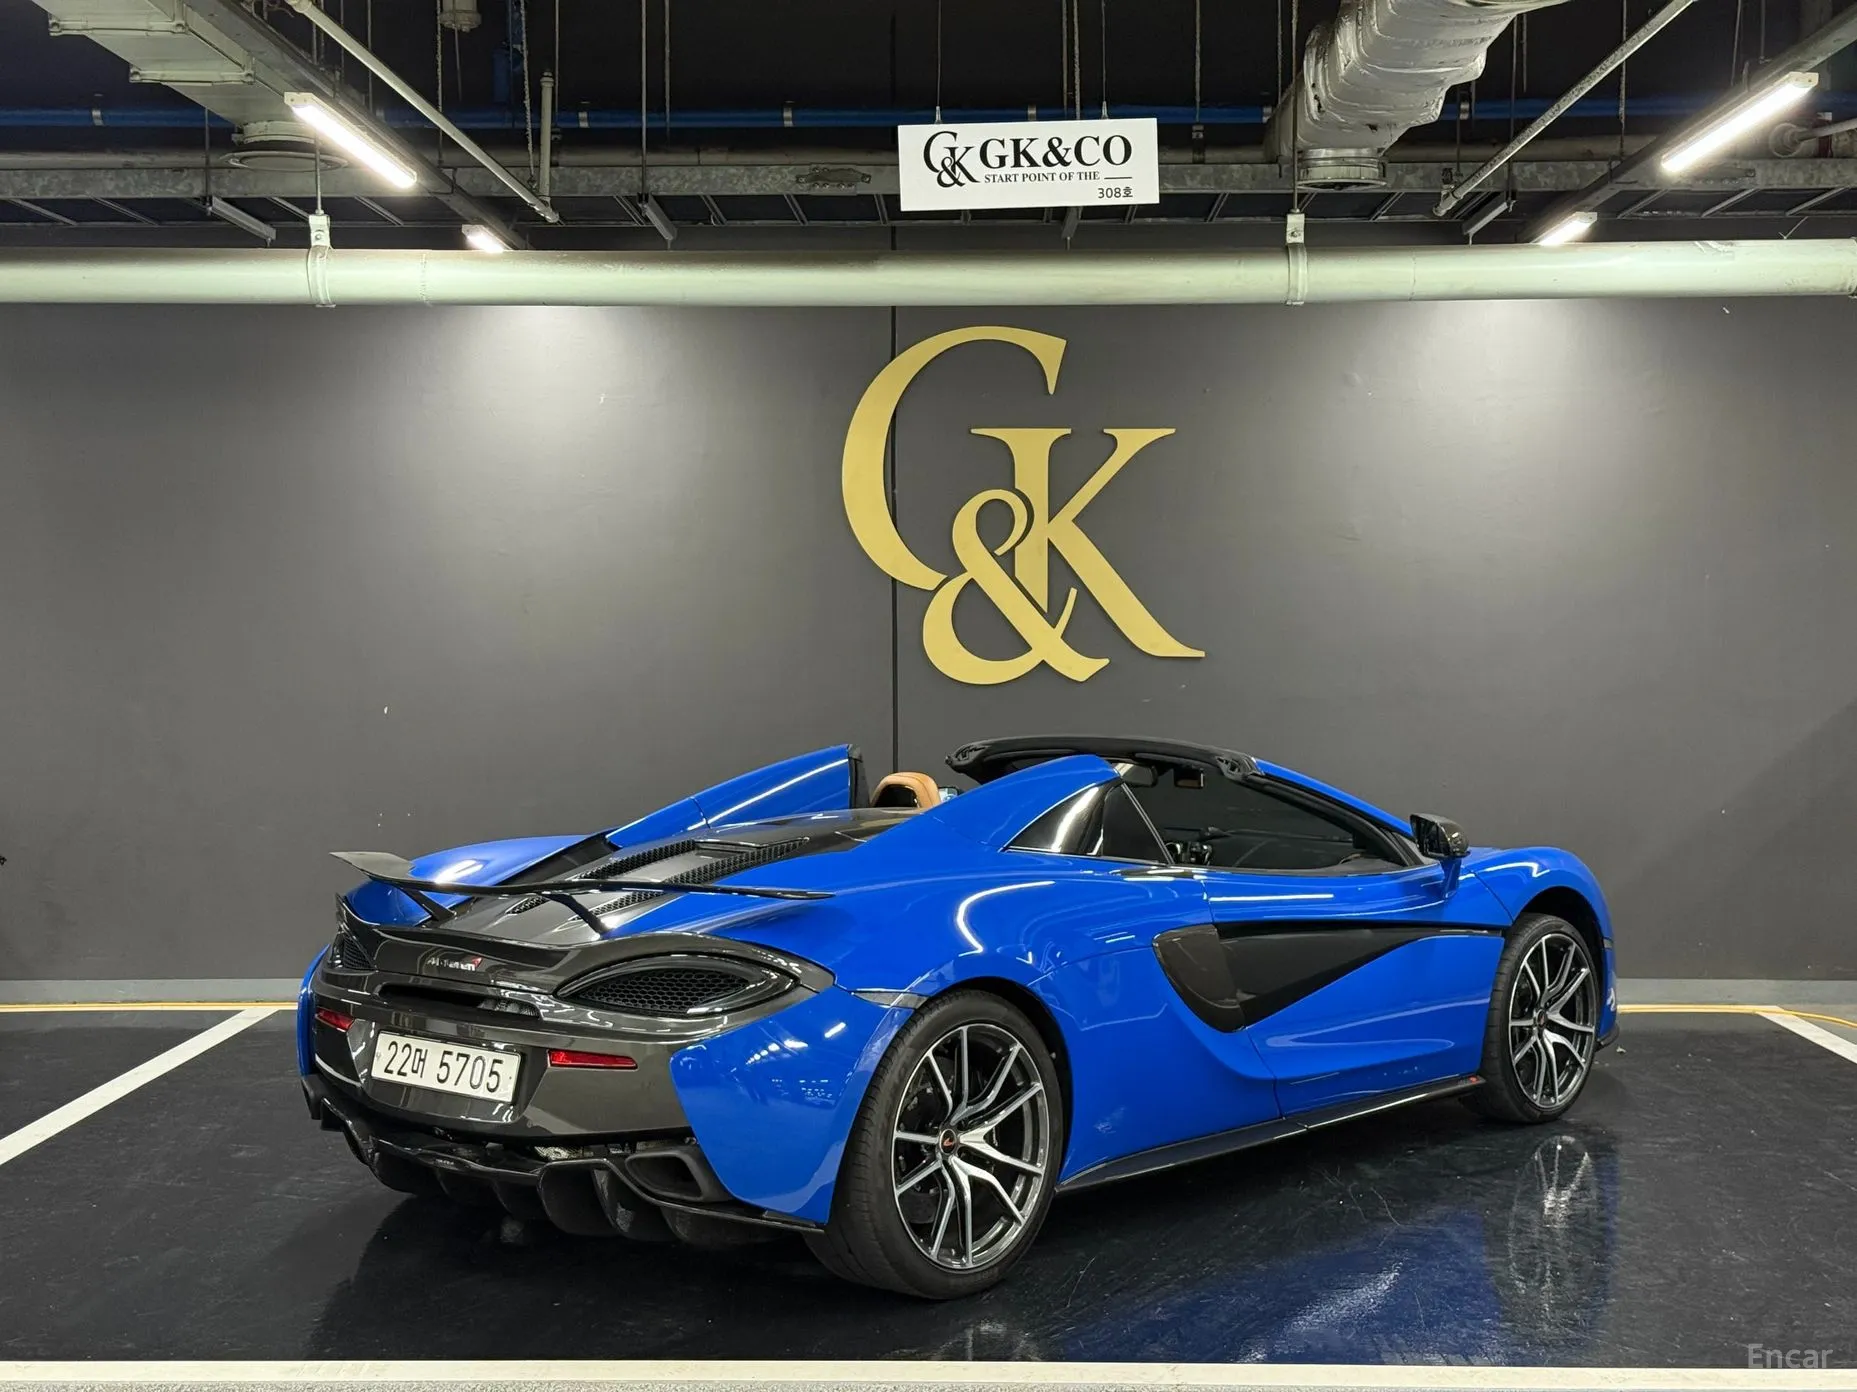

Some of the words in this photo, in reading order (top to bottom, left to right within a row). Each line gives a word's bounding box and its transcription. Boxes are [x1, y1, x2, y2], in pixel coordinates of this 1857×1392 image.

[979, 134, 1133, 169] GK&CO
[984, 173, 1020, 183] START
[1021, 172, 1057, 182] POINT
[1059, 171, 1075, 181] OF
[1076, 170, 1101, 180] THE
[1097, 186, 1134, 199] 308호
[384, 1040, 429, 1079] 22머
[436, 1051, 504, 1094] 5705
